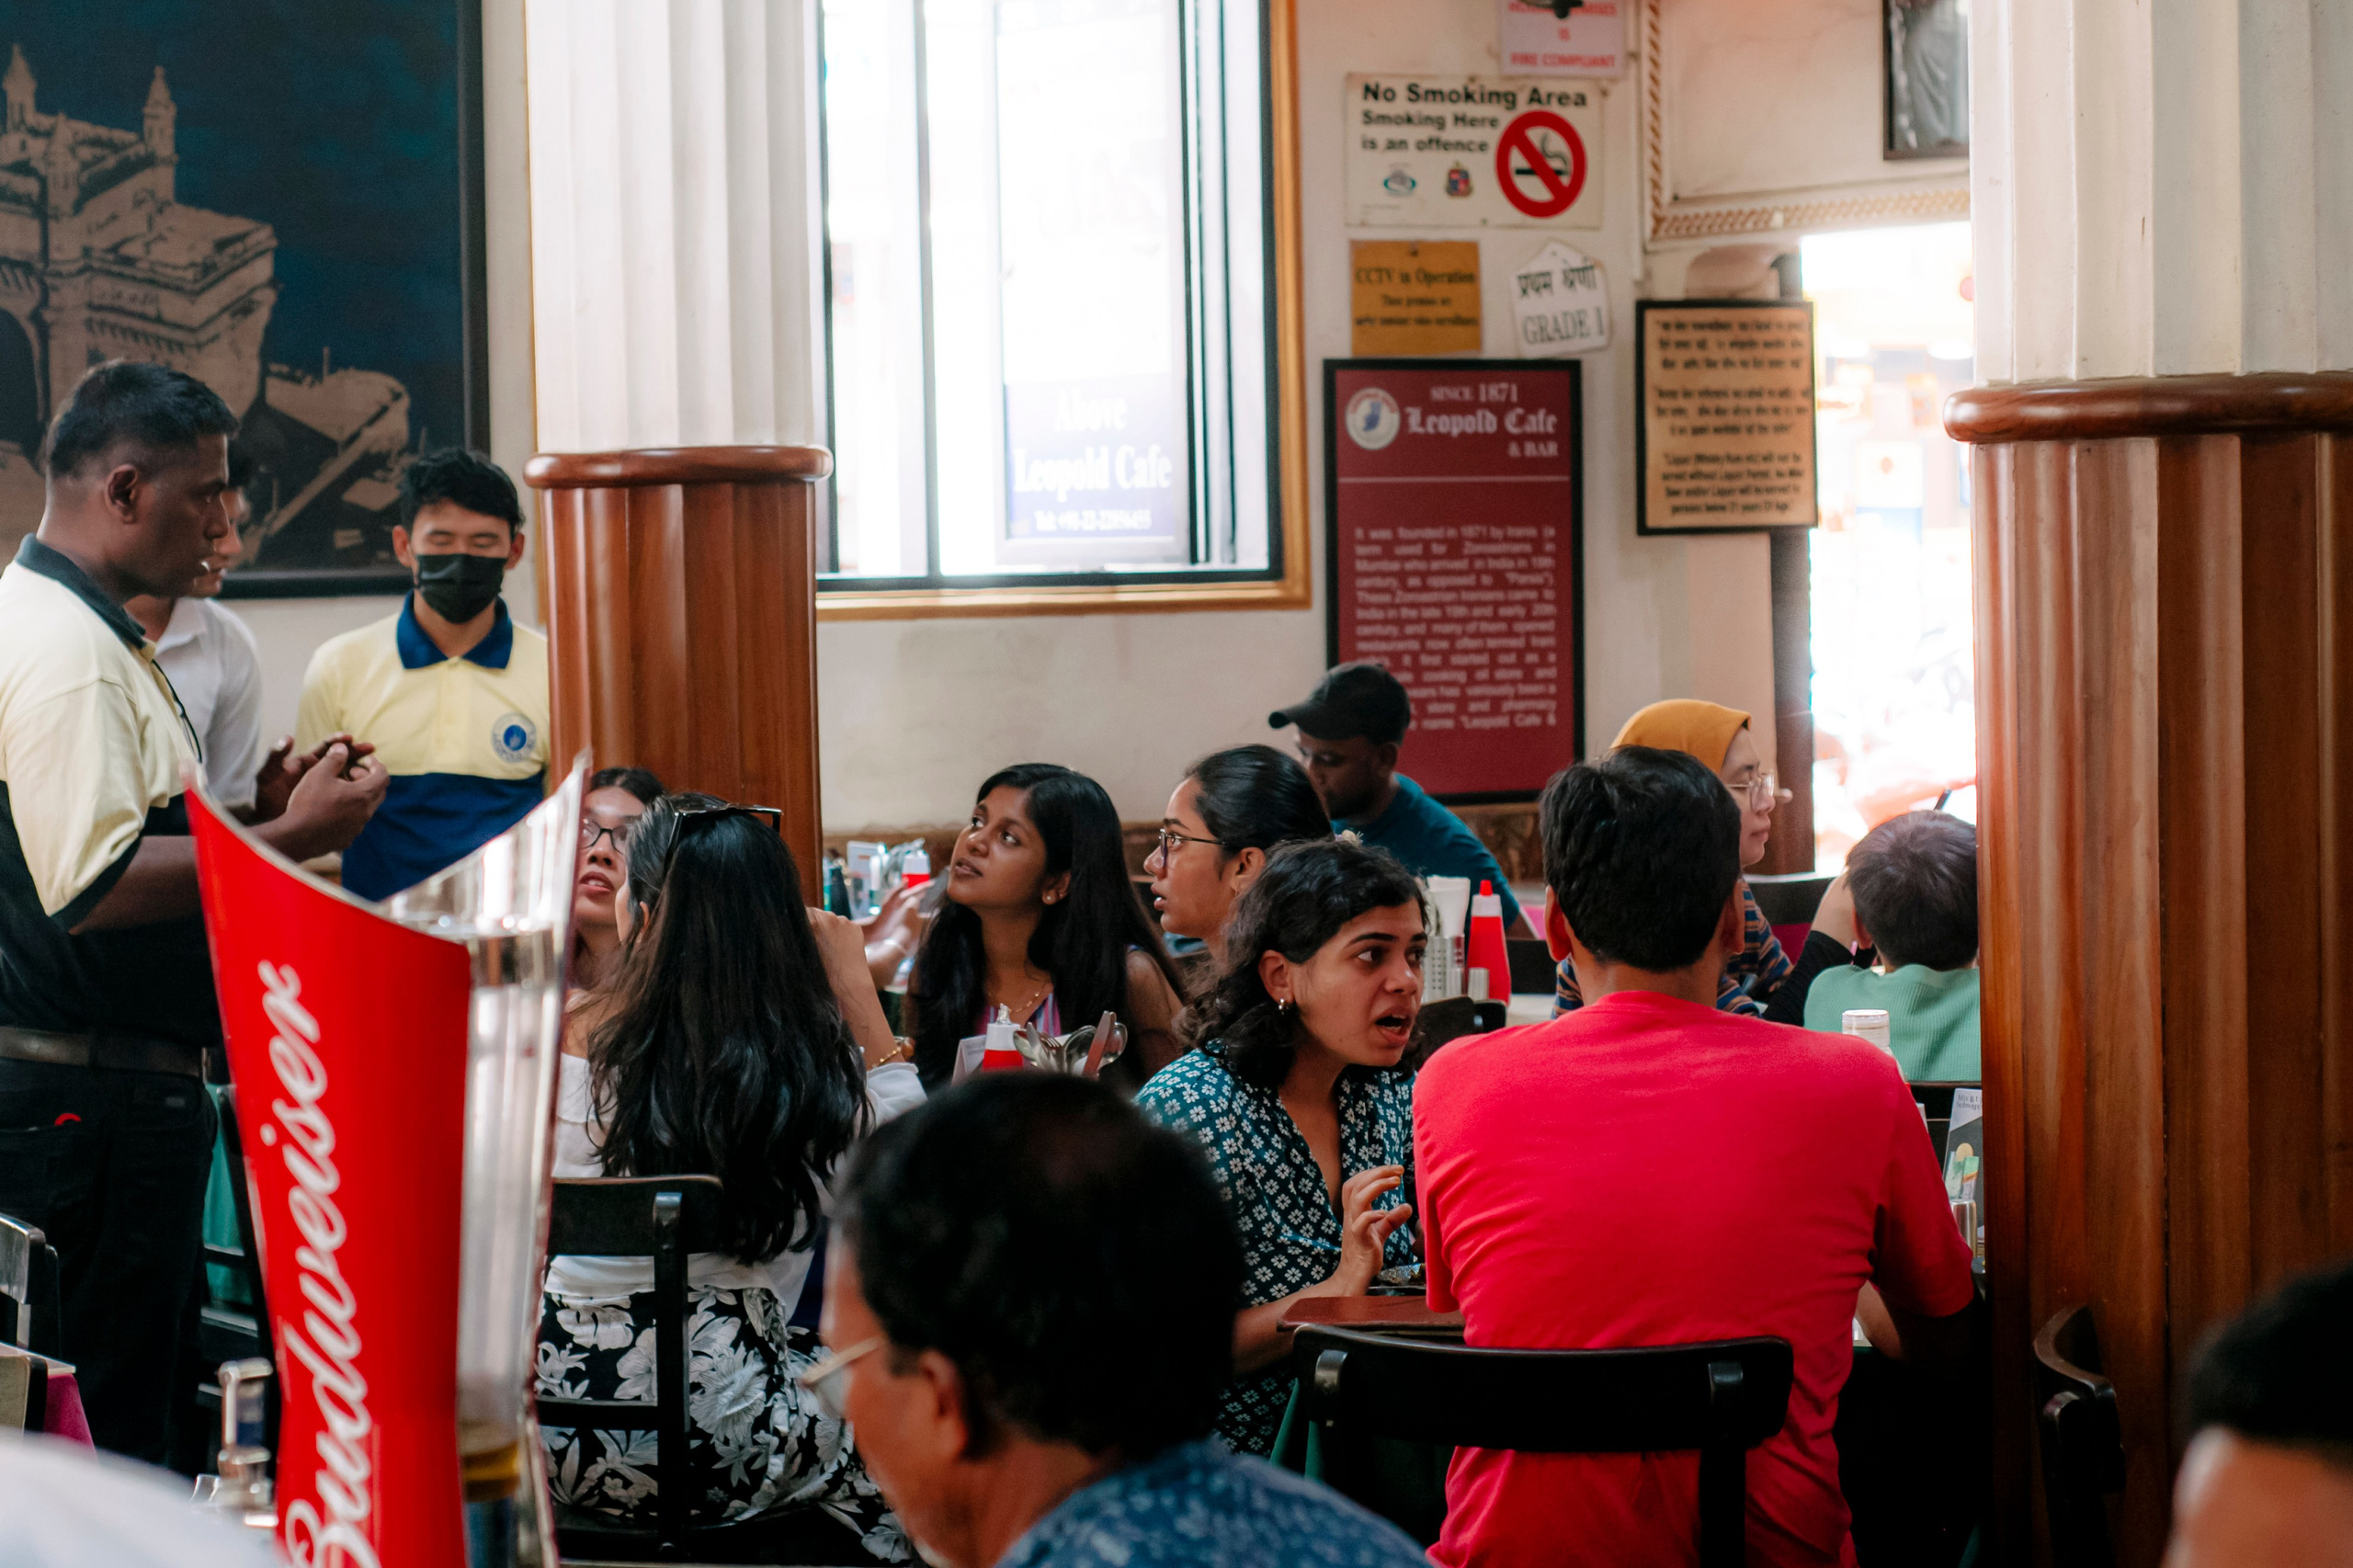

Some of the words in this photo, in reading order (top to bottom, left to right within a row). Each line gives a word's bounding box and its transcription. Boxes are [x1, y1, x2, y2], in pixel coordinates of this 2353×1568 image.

[1362, 83, 1396, 102] No
[1407, 83, 1517, 110] Smoking
[1528, 87, 1587, 107] Area
[1361, 109, 1446, 130] Smoking
[1453, 112, 1500, 128] Here
[1361, 137, 1378, 151] is
[1385, 138, 1409, 151] an
[1415, 136, 1489, 153] offence
[1355, 267, 1394, 285] CCTV
[1400, 269, 1411, 284] in
[1415, 267, 1475, 288] Operation
[1523, 309, 1591, 345] GRADE
[1430, 386, 1473, 403] SINCE
[1478, 382, 1518, 403] 1871
[1404, 406, 1498, 437] Leopold
[1504, 406, 1558, 435] Cafe
[1507, 441, 1521, 457] &
[1523, 440, 1559, 458] BAR
[1013, 444, 1110, 503] Leopold
[1114, 443, 1173, 490] Cafe
[257, 959, 381, 1568] Budweiser
